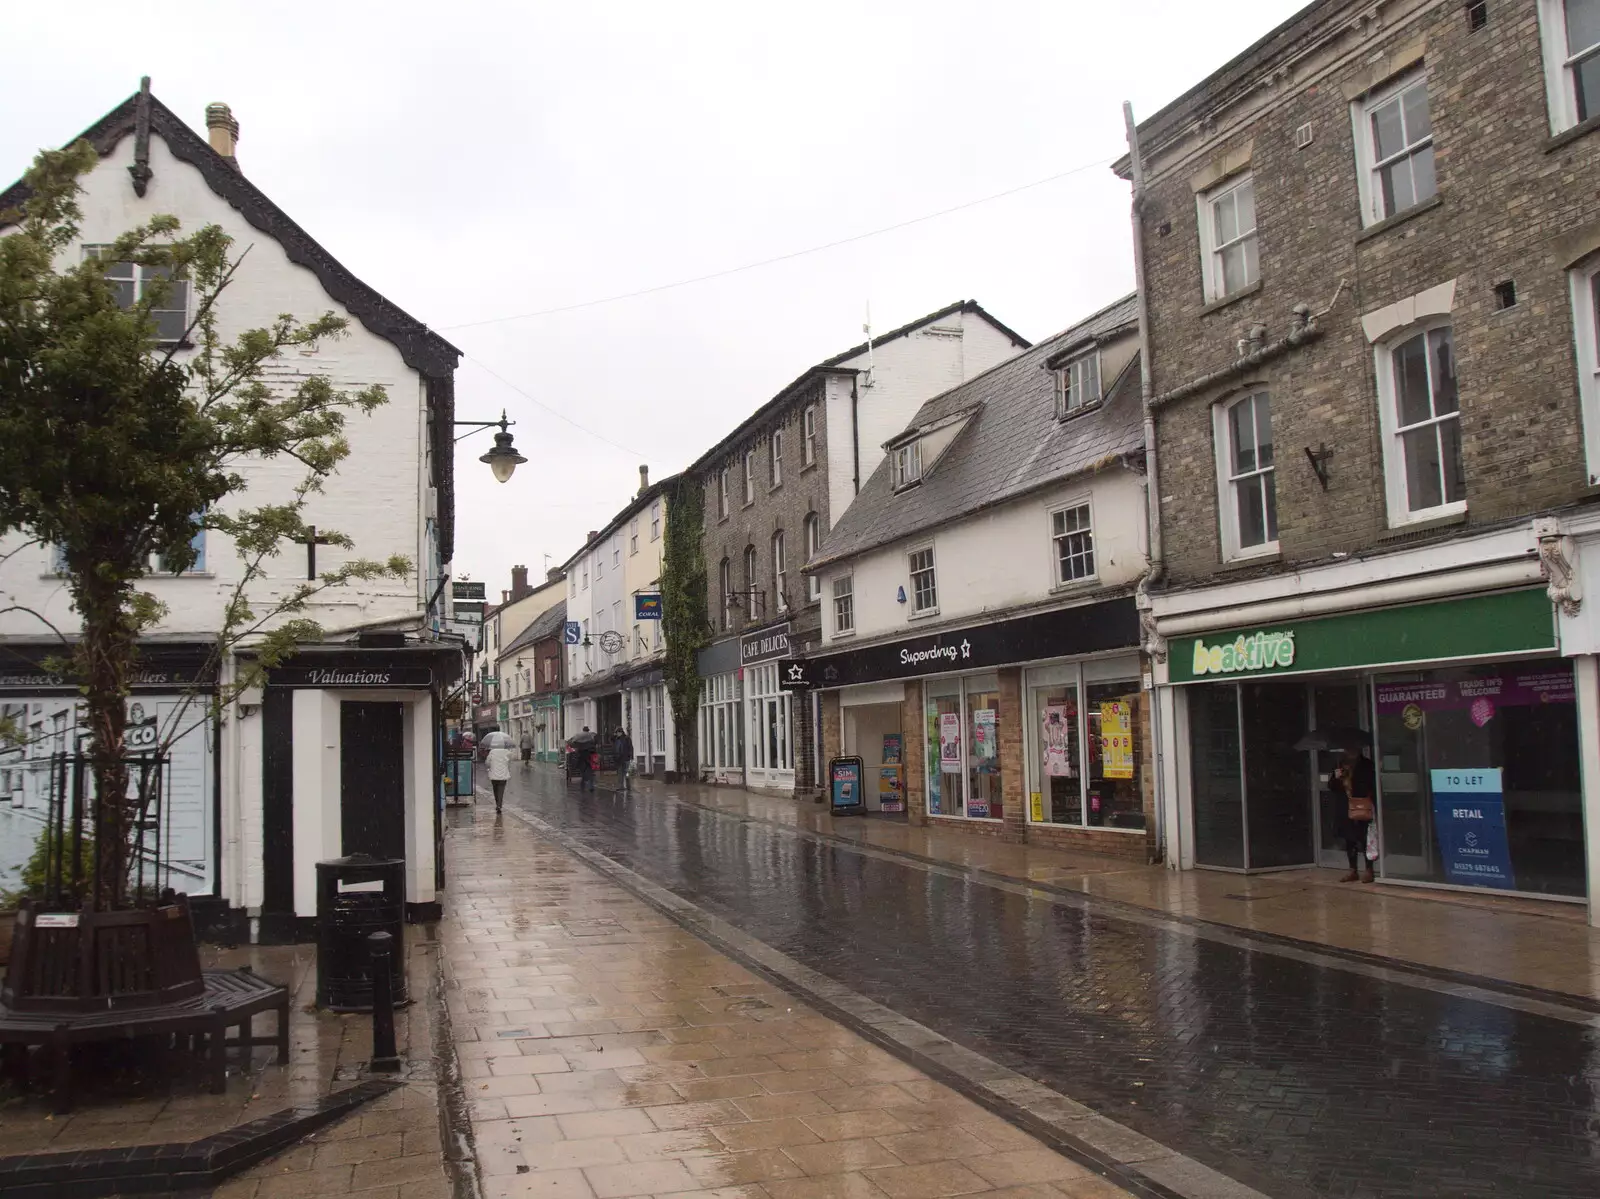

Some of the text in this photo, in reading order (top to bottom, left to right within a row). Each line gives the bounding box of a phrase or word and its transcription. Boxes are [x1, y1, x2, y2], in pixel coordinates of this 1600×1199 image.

[566, 628, 577, 643] S
[743, 633, 788, 658] CAFE DELICES
[900, 645, 958, 666] Superdrug
[1193, 632, 1295, 675] beactive
[308, 668, 391, 684] Valuations
[1459, 679, 1485, 689] TRADE
[1379, 689, 1446, 703] GUARANTEED
[1461, 686, 1501, 697] WELCOME
[838, 770, 853, 779] SIM
[1447, 776, 1484, 785] TO LET
[1452, 808, 1484, 819] RETAIL
[1458, 847, 1489, 855] CHAPMAN
